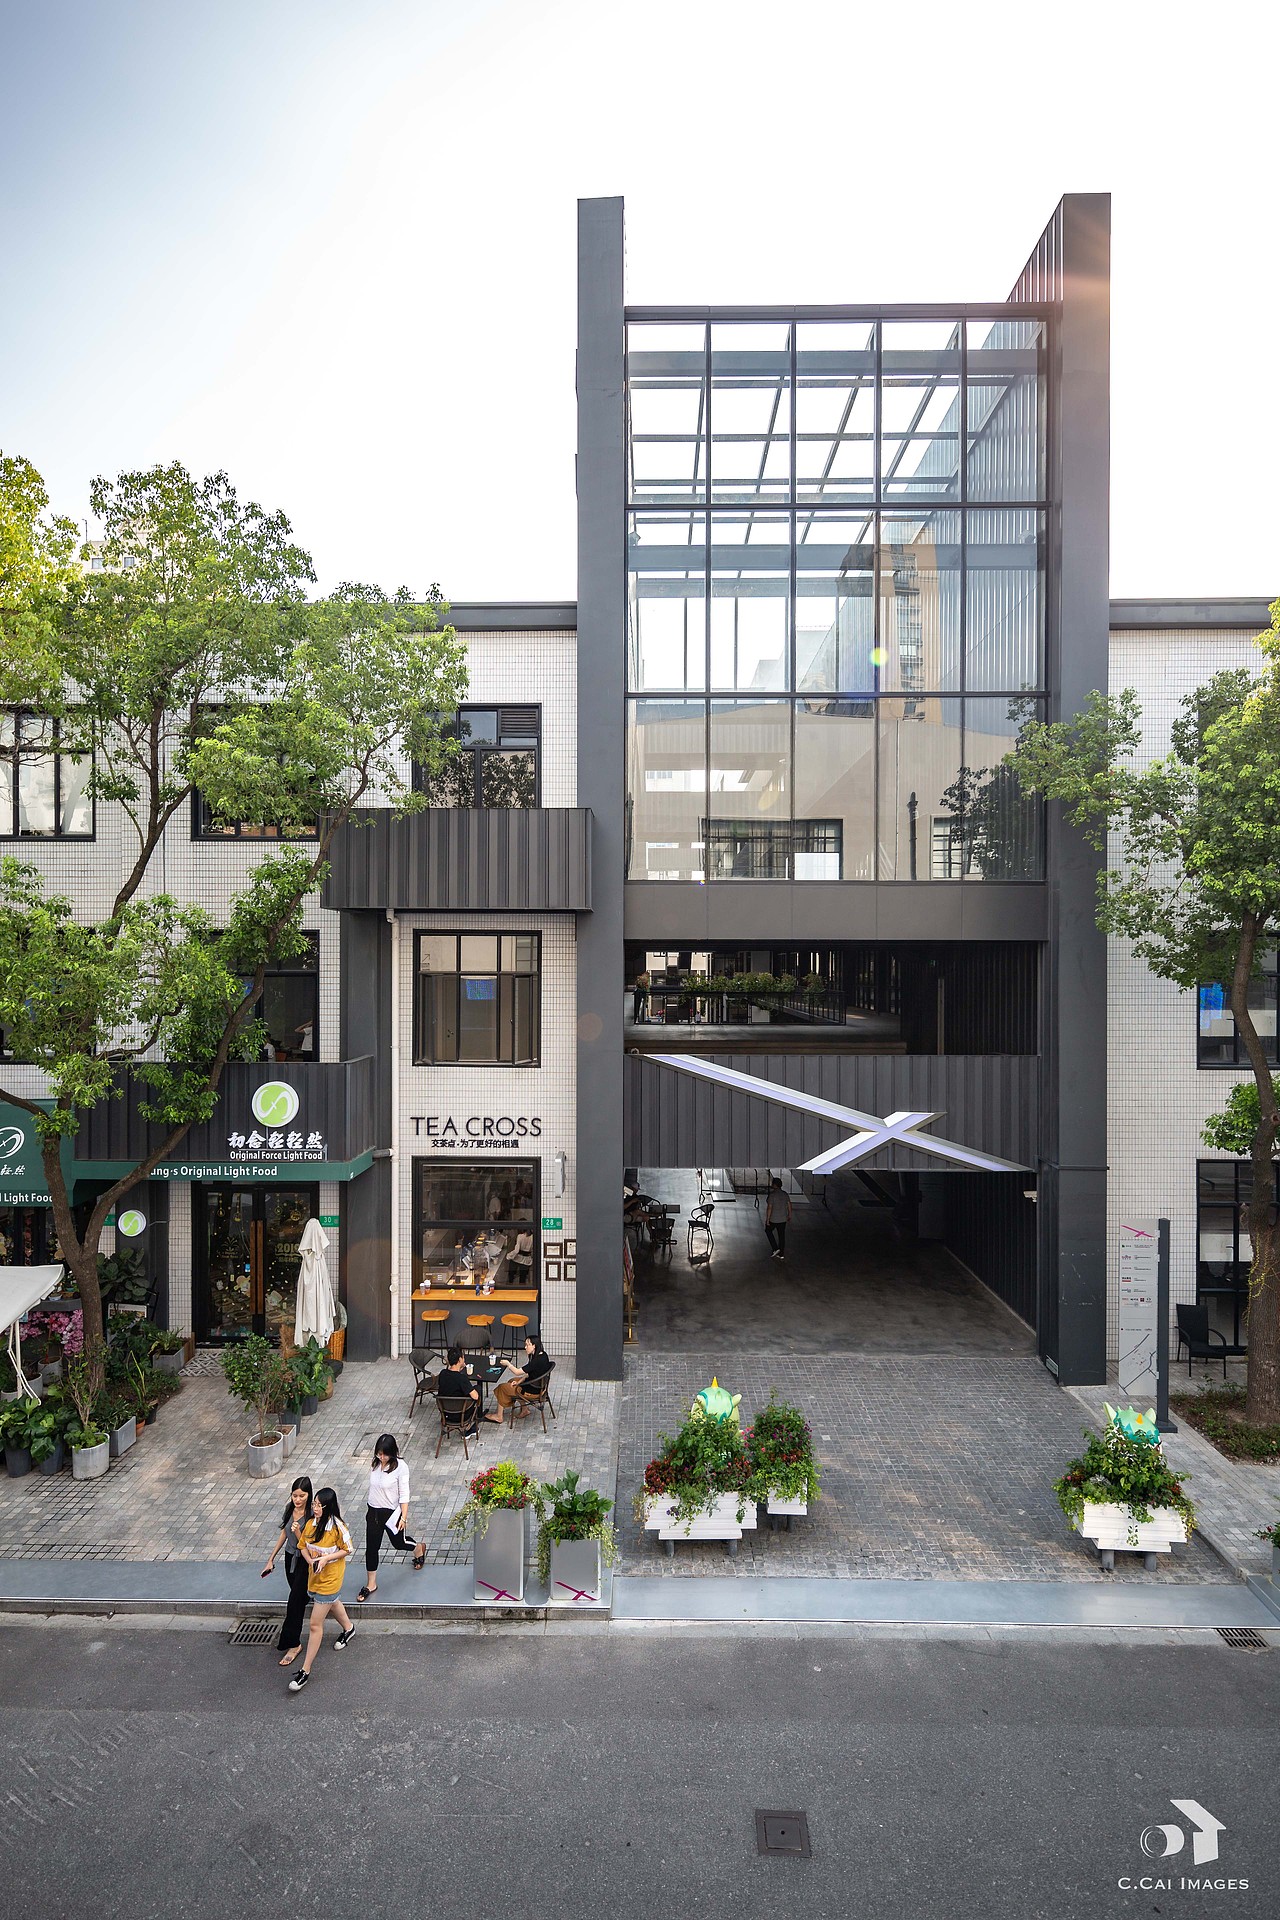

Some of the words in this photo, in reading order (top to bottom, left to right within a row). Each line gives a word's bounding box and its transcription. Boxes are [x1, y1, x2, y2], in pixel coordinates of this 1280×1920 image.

[410, 1116, 458, 1136] TEA
[465, 1116, 542, 1137] CROSS
[230, 1151, 260, 1161] Original
[261, 1151, 282, 1160] Force
[283, 1151, 303, 1161] Light
[304, 1151, 323, 1160] Food
[180, 1165, 221, 1178] Original
[224, 1165, 251, 1178] Light
[252, 1165, 278, 1176] Food
[4, 1192, 29, 1205] Light
[545, 1218, 554, 1226] 28
